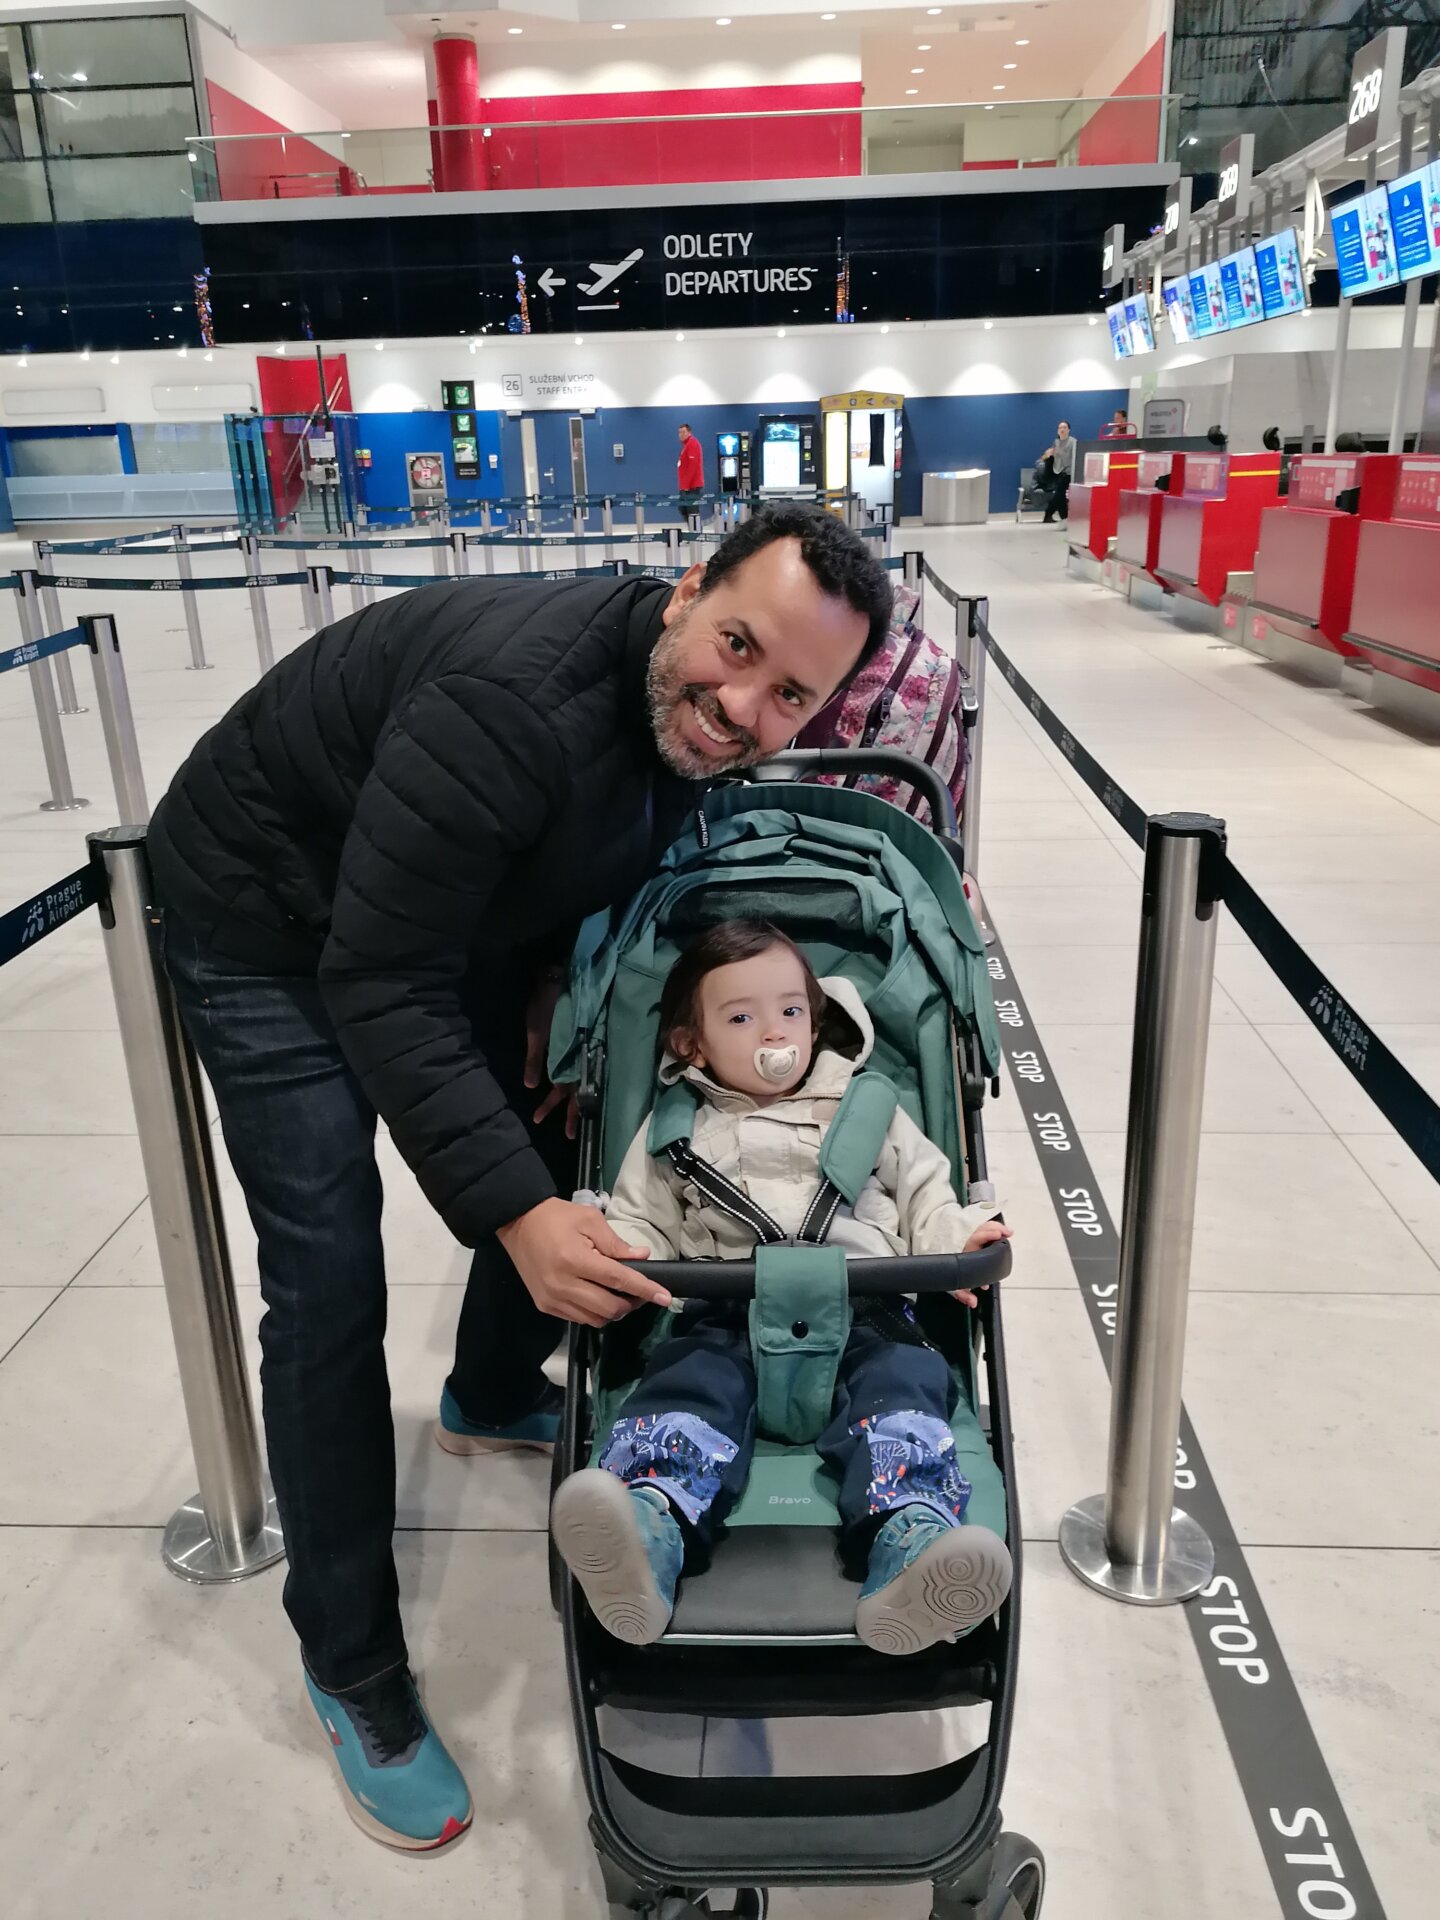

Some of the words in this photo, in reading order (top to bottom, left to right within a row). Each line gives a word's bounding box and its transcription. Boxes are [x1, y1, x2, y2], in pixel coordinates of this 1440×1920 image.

[1349, 68, 1382, 125] 268
[663, 232, 753, 259] ODLETY
[665, 267, 813, 296] DEPARTURES
[505, 380, 520, 391] 26
[529, 373, 566, 384] SLUŽEBNÍ
[568, 374, 595, 383] VCHOD
[536, 386, 560, 395] STAFF
[46, 880, 82, 909] Prague
[49, 893, 84, 925] Airport
[994, 1000, 1024, 1028] STOP
[1335, 999, 1369, 1051] Prague
[1331, 1018, 1366, 1071] Airport
[1011, 1051, 1045, 1083] STOP
[1033, 1112, 1072, 1152] STOP
[1059, 1188, 1103, 1236] STOP
[768, 1495, 812, 1505] Bravo
[1200, 1575, 1270, 1685] STOP
[1269, 1807, 1357, 1920] STO
